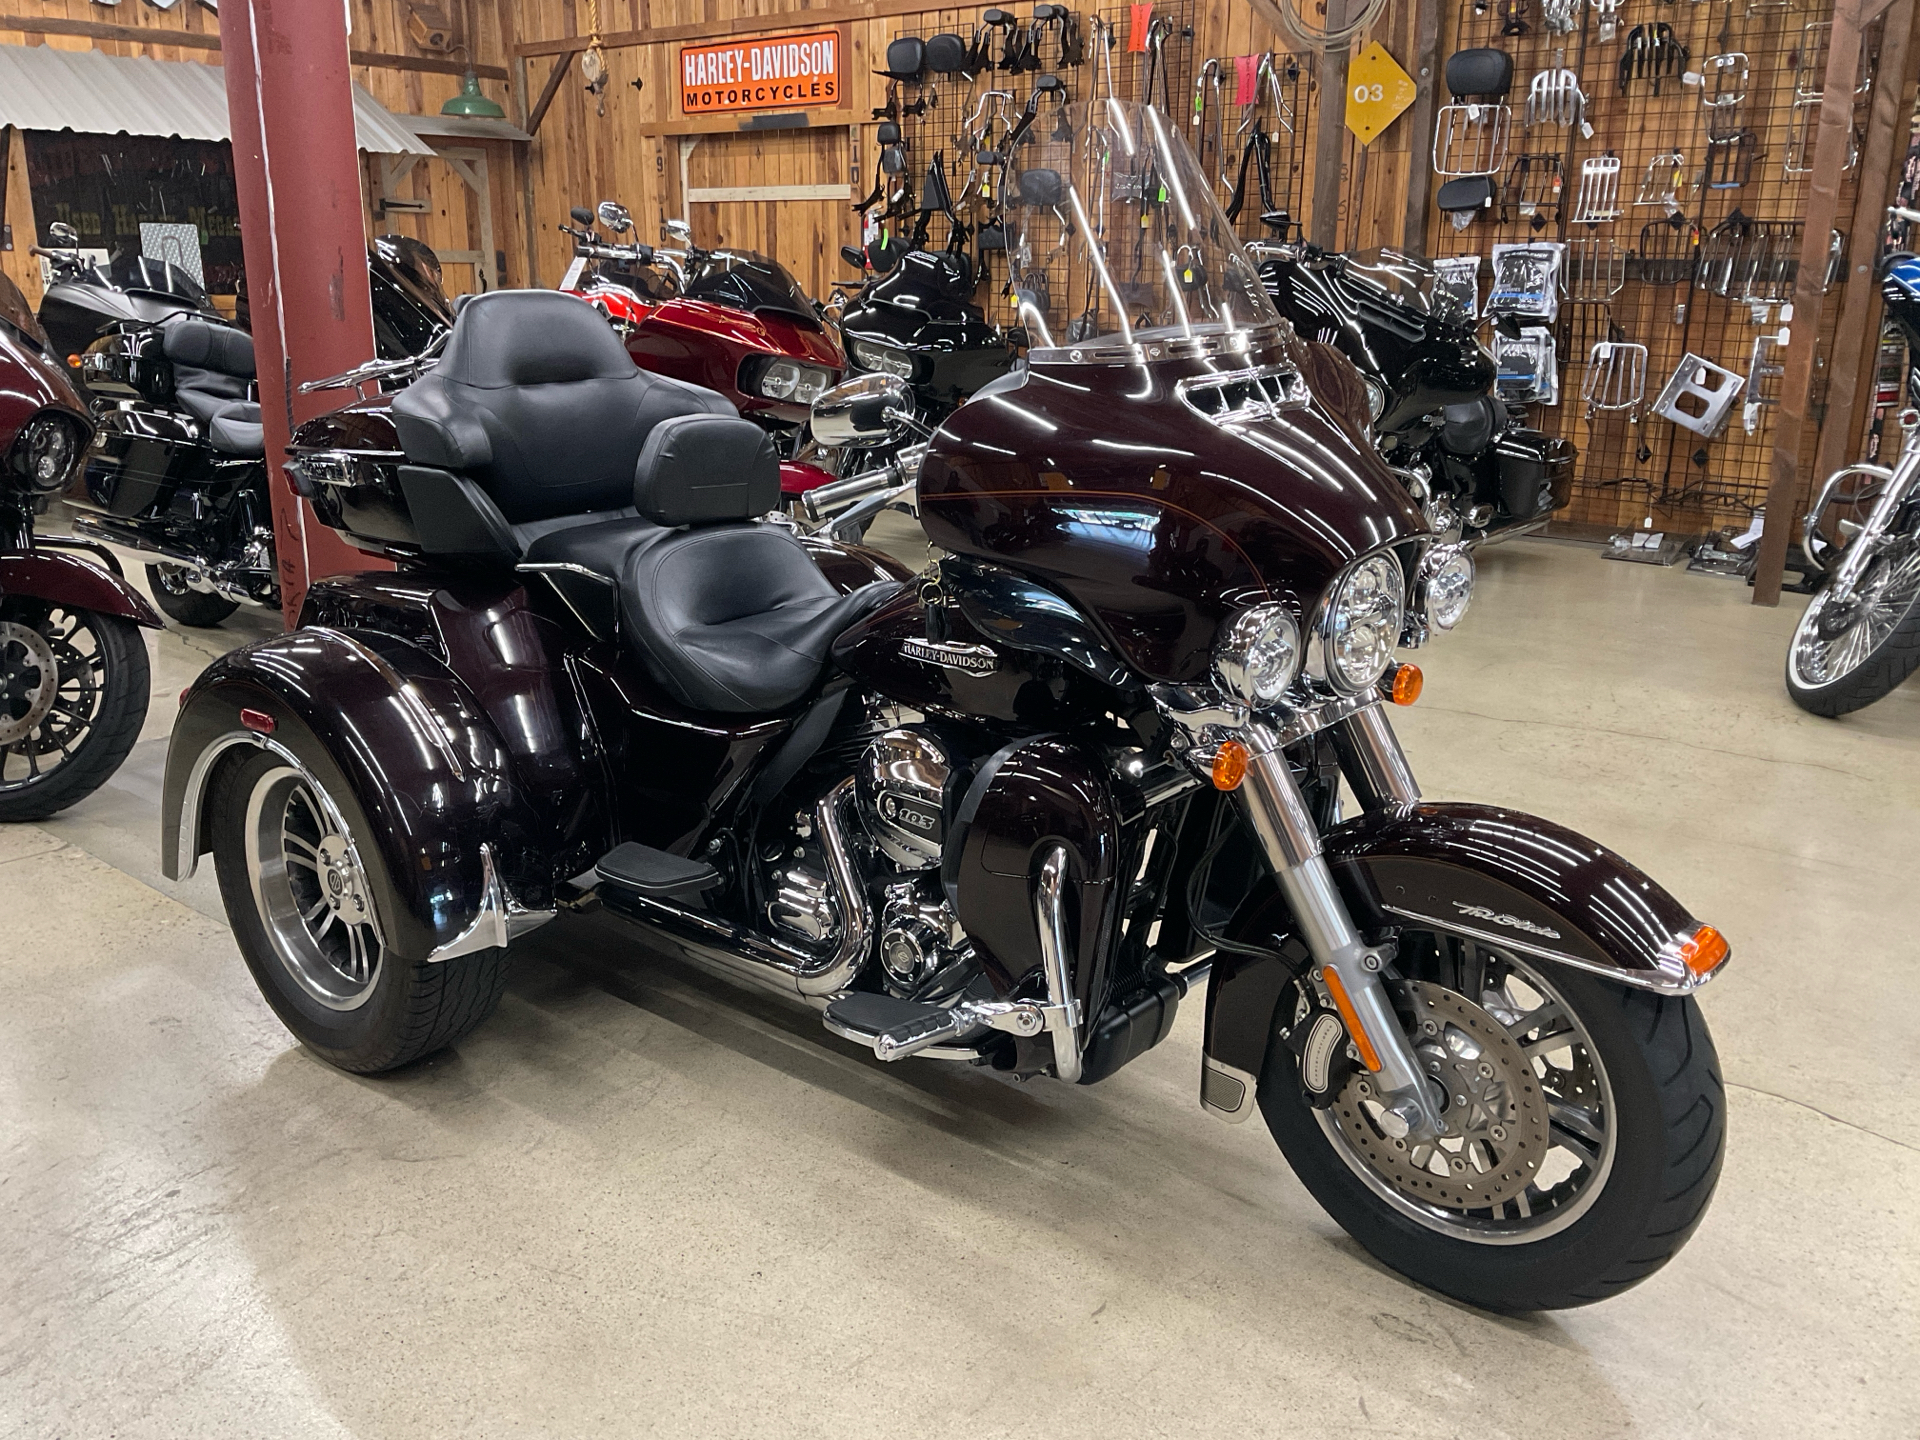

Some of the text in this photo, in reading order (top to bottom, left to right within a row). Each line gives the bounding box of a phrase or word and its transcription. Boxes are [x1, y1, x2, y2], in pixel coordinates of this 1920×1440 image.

[685, 40, 834, 87] HARLEY-DAVIDSON
[686, 81, 835, 107] MOTORCYCLES
[1353, 83, 1384, 104] 03
[903, 642, 994, 669] HARLEY-DAVIDSON
[898, 807, 936, 830] 103
